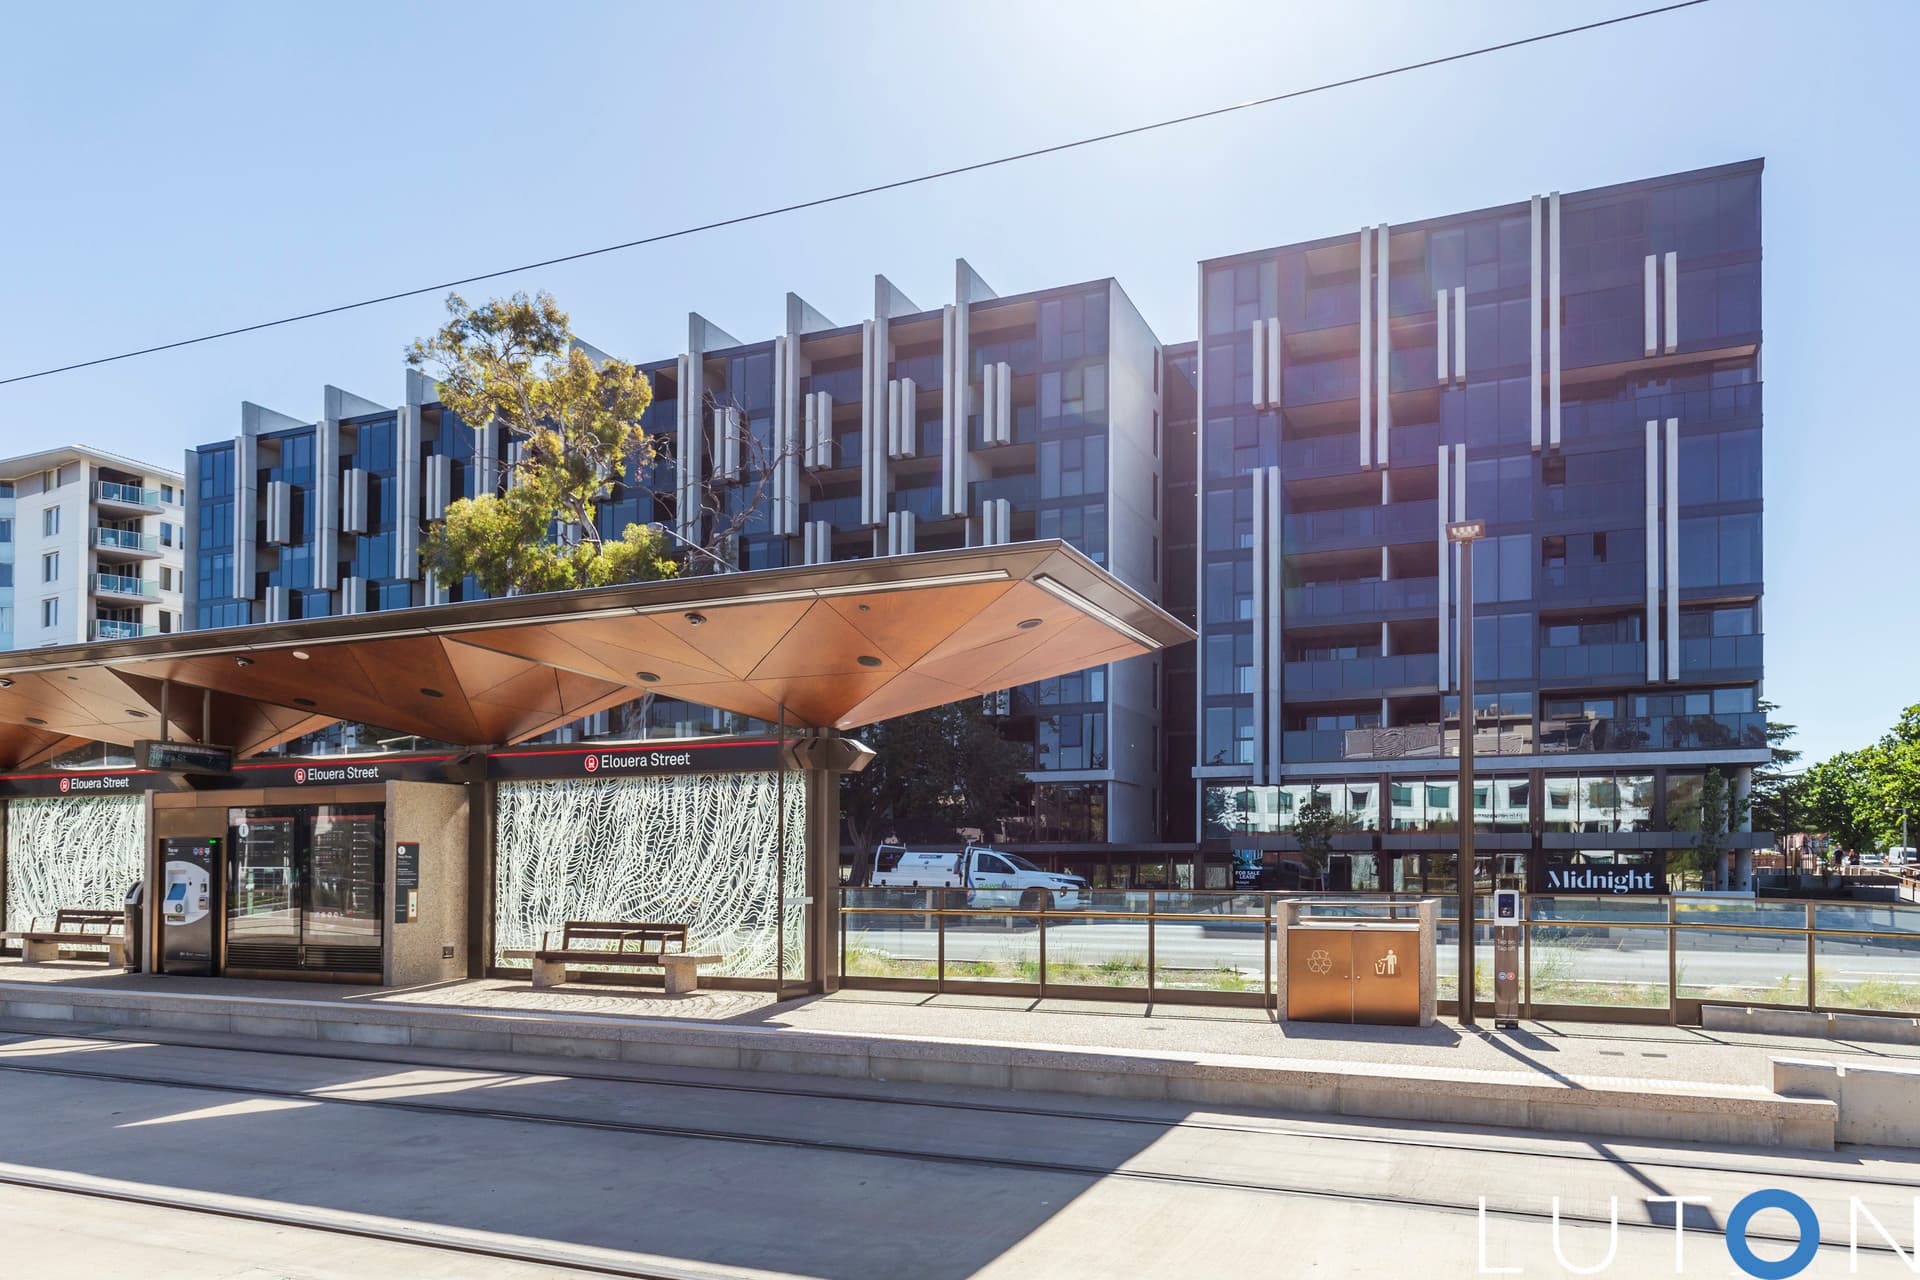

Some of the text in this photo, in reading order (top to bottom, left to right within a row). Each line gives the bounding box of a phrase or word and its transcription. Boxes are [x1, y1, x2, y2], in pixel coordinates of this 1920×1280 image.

[601, 752, 690, 768] Elouera Street
[307, 766, 379, 781] Elouera Street
[70, 776, 129, 790] Elouera Street
[1547, 869, 1654, 894] Midnight
